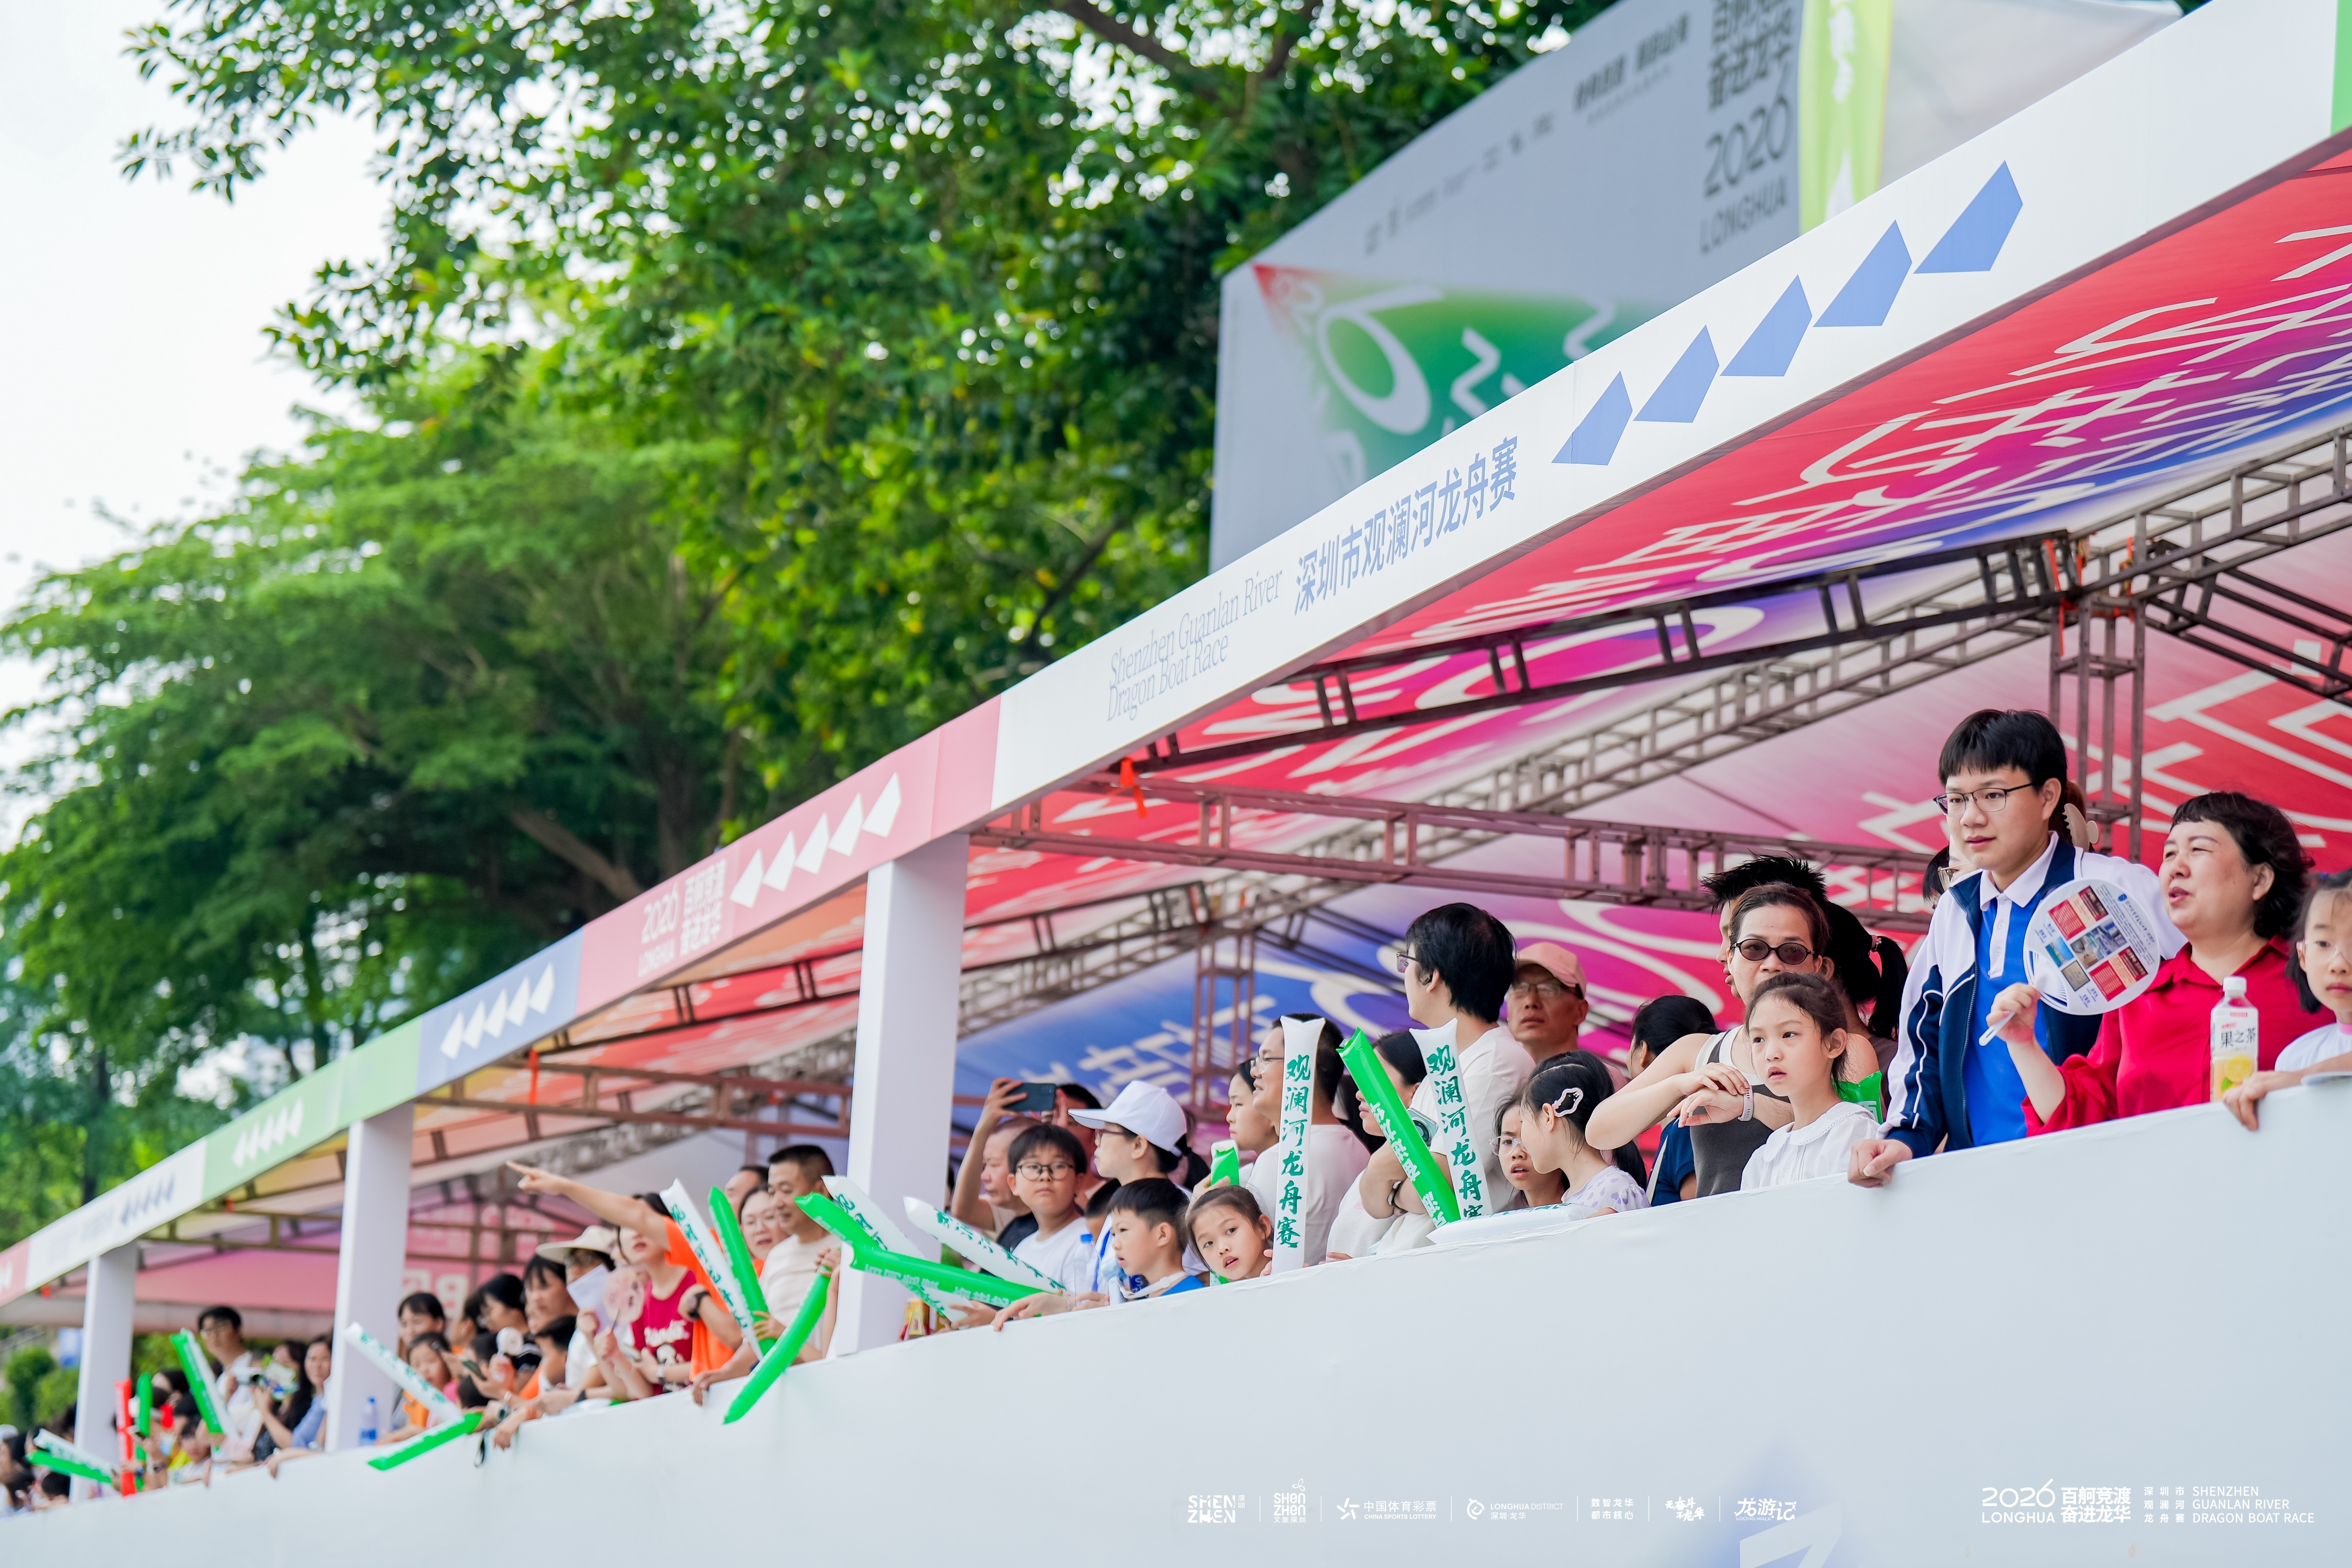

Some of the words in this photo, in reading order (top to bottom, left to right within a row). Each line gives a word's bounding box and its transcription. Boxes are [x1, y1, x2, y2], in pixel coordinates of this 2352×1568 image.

[1294, 436, 1518, 617] 深圳市观澜河龙舟赛
[1106, 674, 1155, 722] Dragon
[1158, 649, 1190, 695] Boat
[1192, 635, 1228, 677] Race
[1109, 629, 1174, 687] Shenzhen
[1179, 590, 1238, 650] Guanlan
[1242, 571, 1283, 616] River
[2219, 1027, 2256, 1048] 果之茶
[1276, 1054, 1311, 1248] 观澜河龙舟赛
